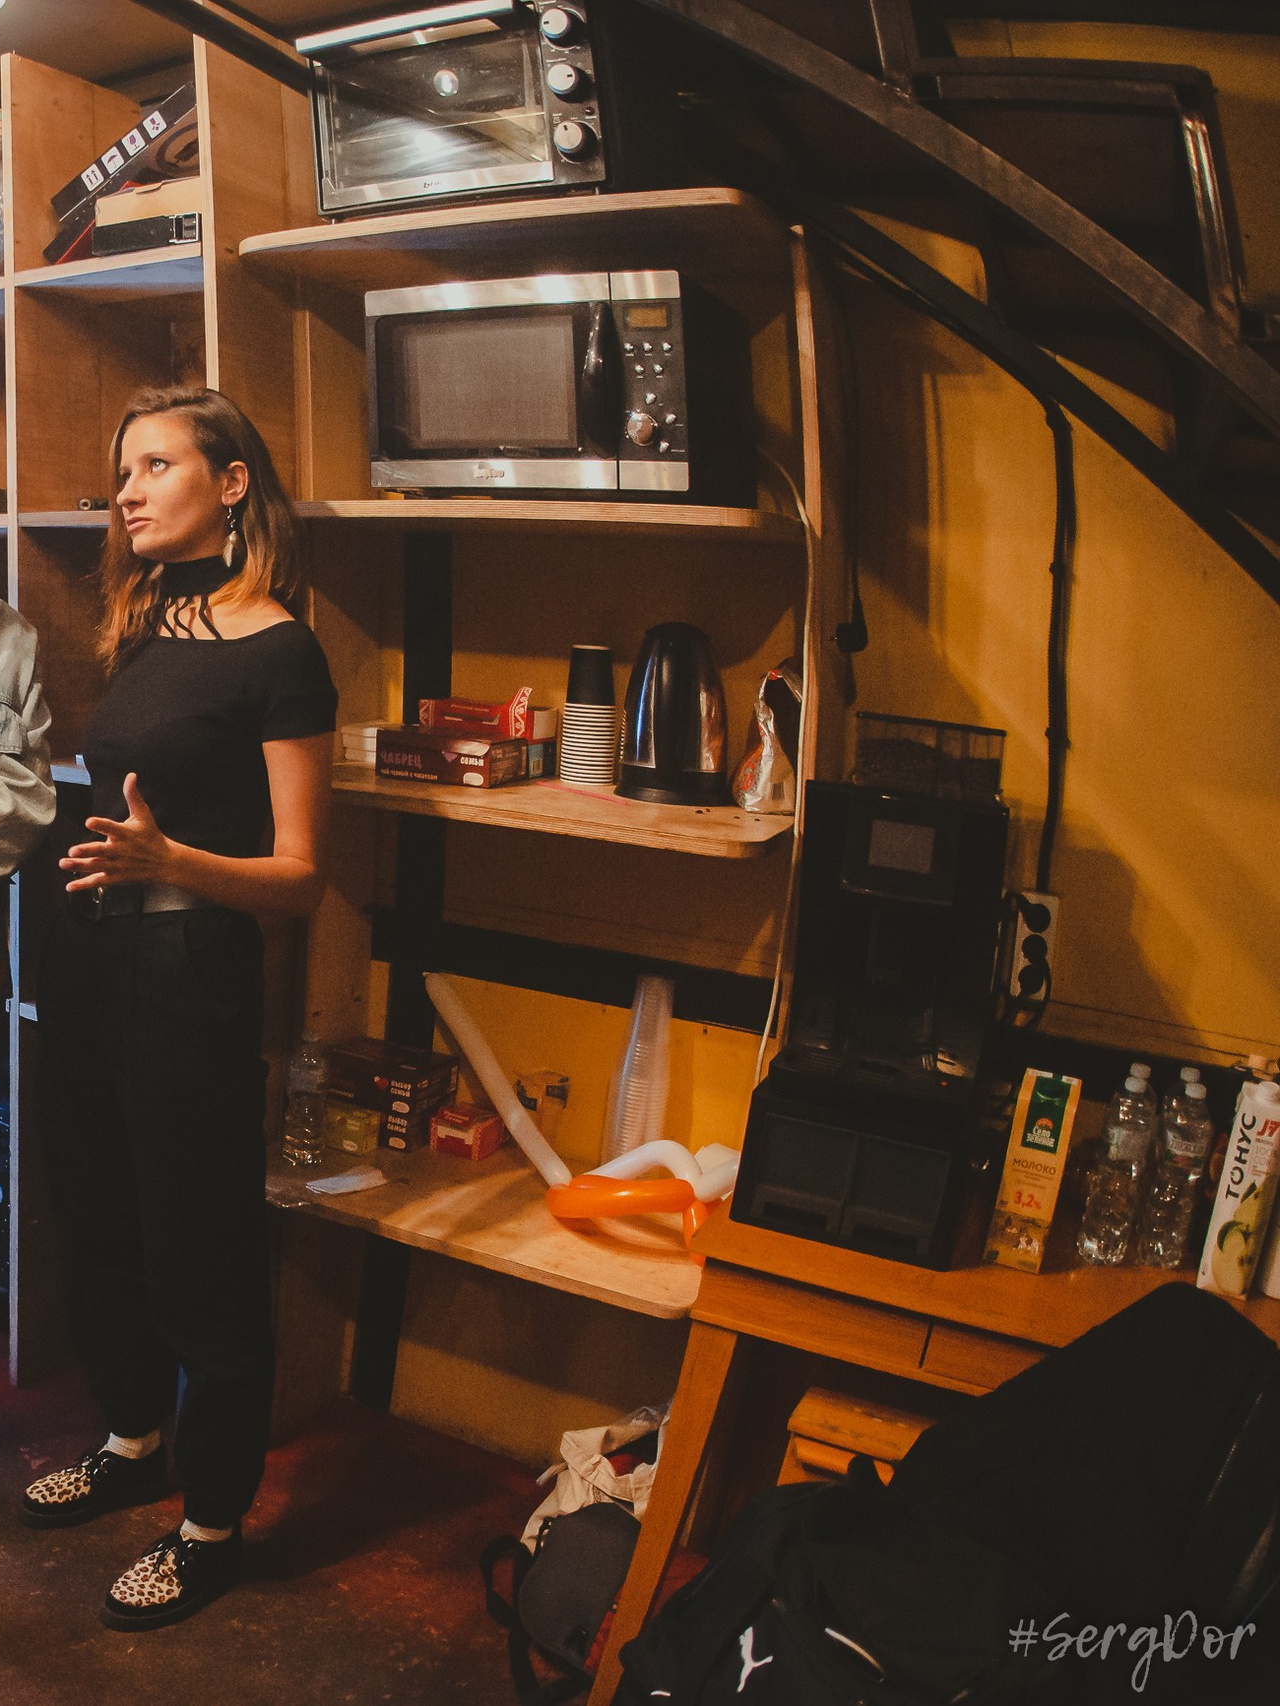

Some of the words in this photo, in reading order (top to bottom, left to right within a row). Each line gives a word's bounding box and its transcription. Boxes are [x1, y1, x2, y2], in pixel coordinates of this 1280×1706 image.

[381, 750, 423, 769] ЧАБРЕЦ
[1225, 1113, 1257, 1200] ТОНУС
[1012, 1158, 1057, 1176] МОЛОКО
